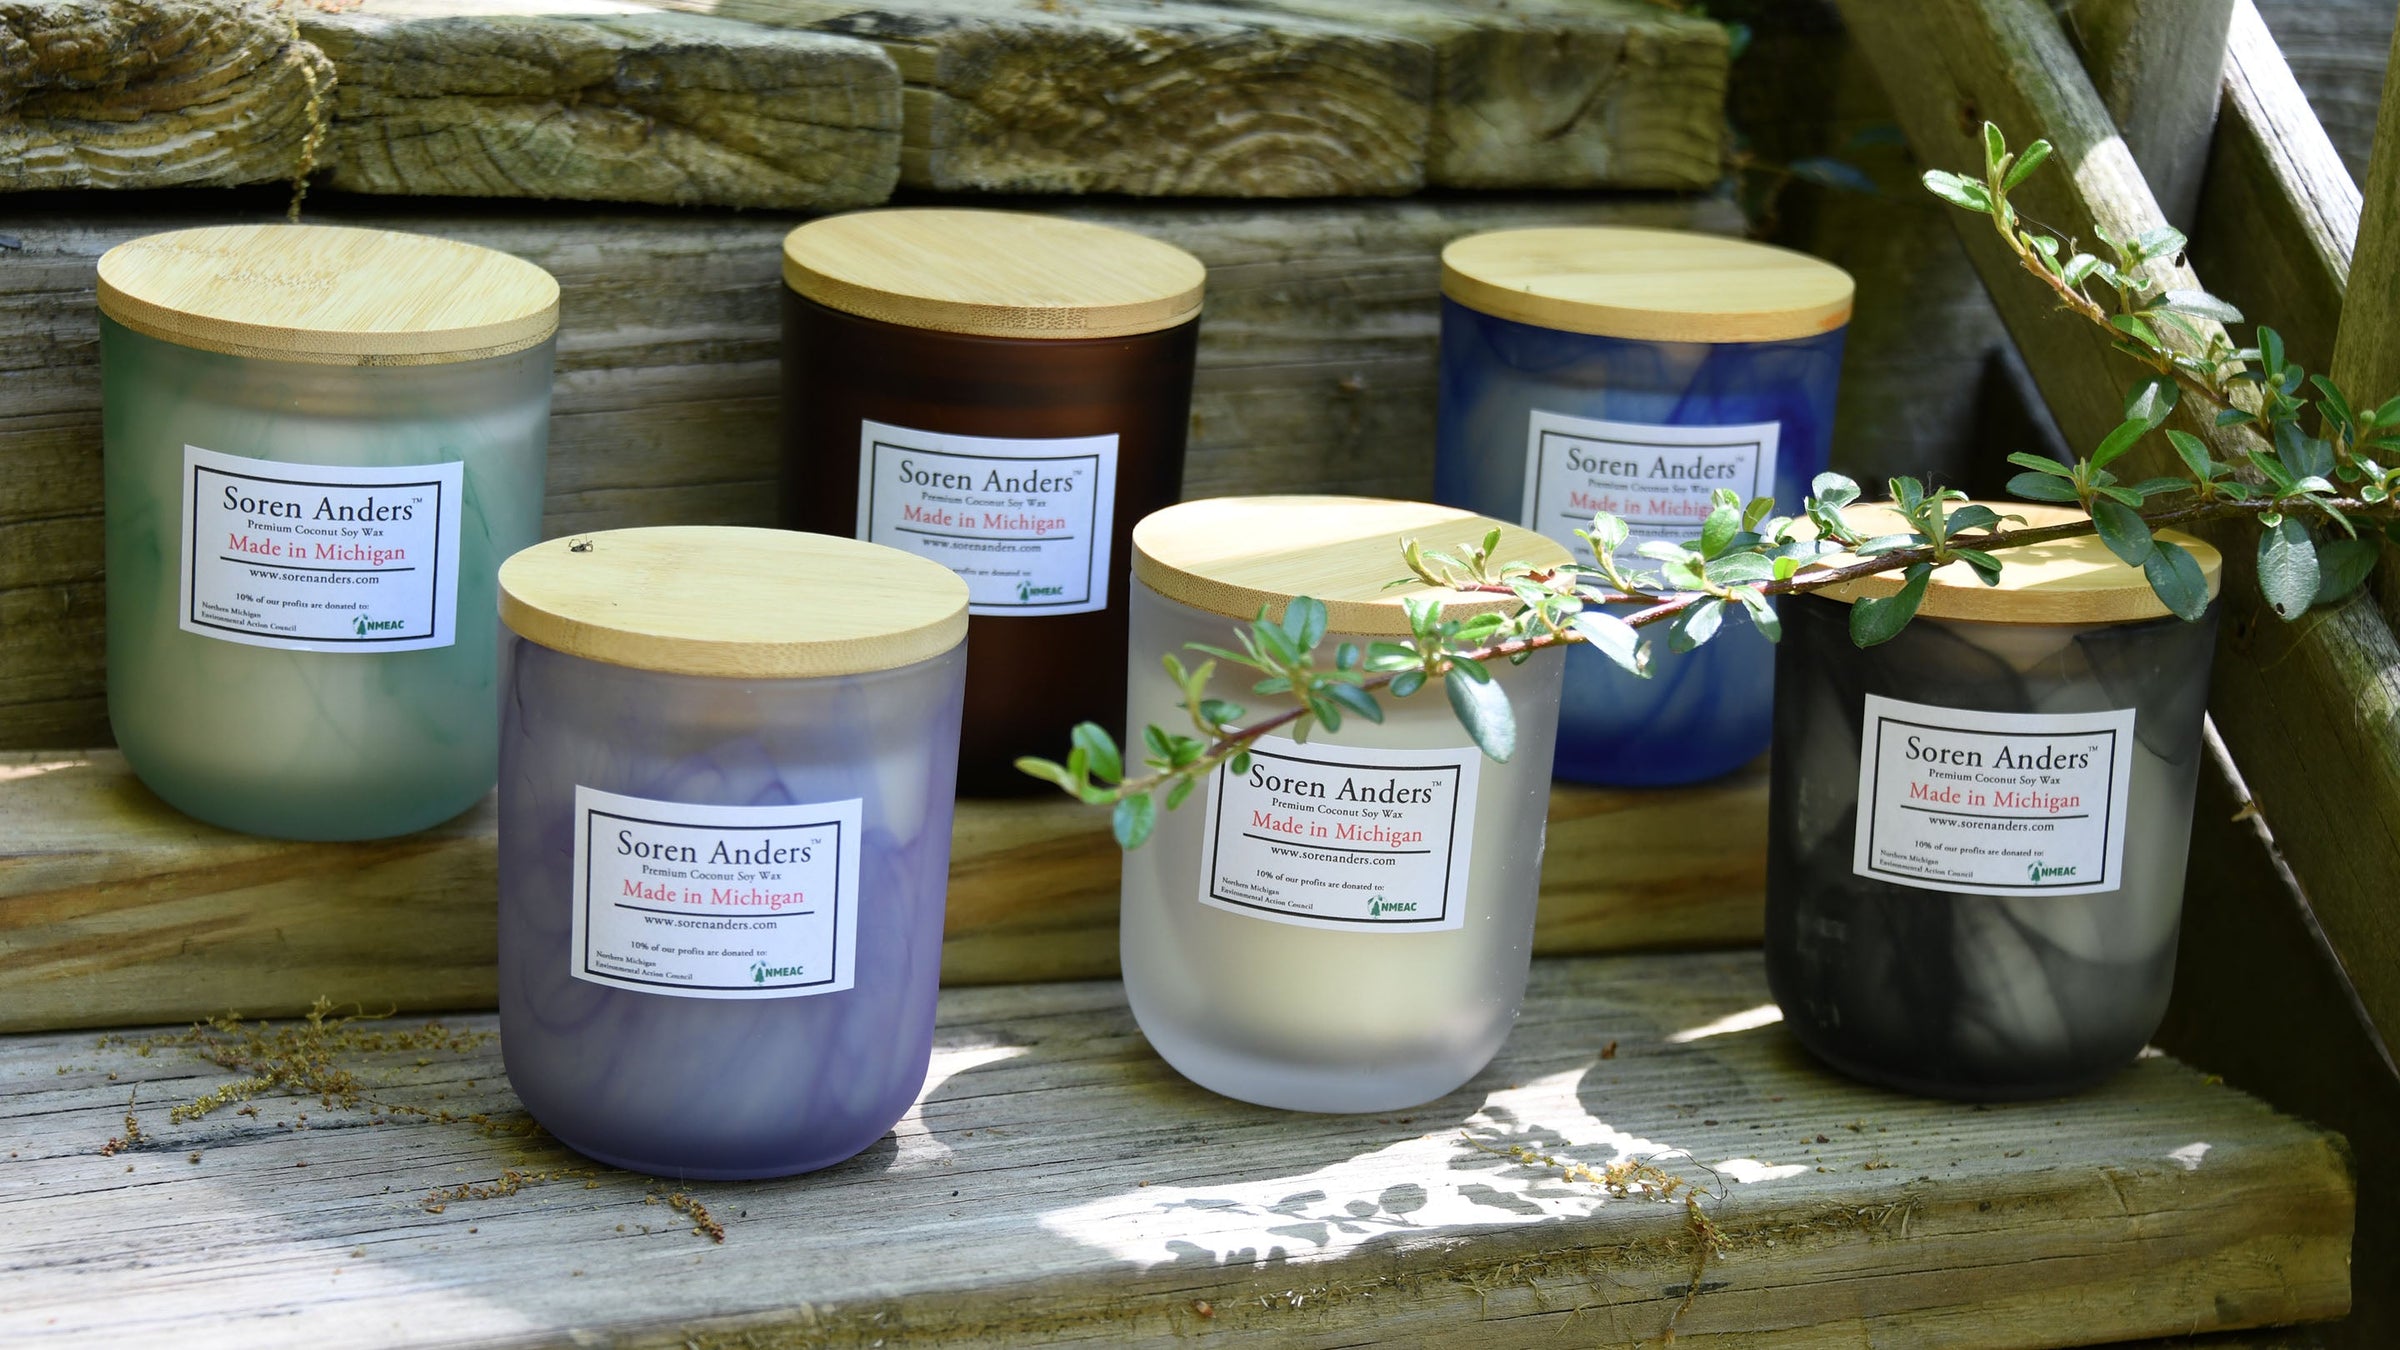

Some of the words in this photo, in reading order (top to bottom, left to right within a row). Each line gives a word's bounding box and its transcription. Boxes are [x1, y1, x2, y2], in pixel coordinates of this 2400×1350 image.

[1566, 448, 1639, 478] Soren
[899, 460, 972, 491] Soren
[223, 486, 302, 519] Soren
[921, 492, 962, 504] Premium
[965, 496, 1004, 507] Coconut
[1007, 499, 1023, 509] Soy
[1027, 499, 1046, 507] Wax
[1569, 491, 1618, 512] Made
[1624, 500, 1640, 515] in
[248, 519, 292, 534] Premium
[295, 524, 338, 537] Coconut
[341, 527, 358, 538] Soy
[361, 528, 384, 537] Wax
[903, 505, 952, 526] Made
[959, 513, 976, 529] in
[983, 513, 1065, 535] Michigan
[228, 533, 281, 556] Made
[288, 543, 307, 559] in
[315, 543, 405, 566] Michigan
[922, 537, 1042, 553] www.sorenanders.com
[249, 569, 379, 585] www.sorenanders.com
[1029, 586, 1063, 596] NMEAC
[236, 593, 254, 602] 10%
[256, 596, 265, 604] of
[282, 600, 308, 610] profits
[324, 601, 356, 610] donated
[230, 608, 261, 619] Michigan
[246, 620, 268, 629] Action
[270, 623, 296, 632] Council
[366, 619, 405, 630] NMEAC
[1905, 735, 1983, 768] Soren
[1249, 764, 1326, 798] Soren
[1929, 768, 1972, 782] Premium
[1975, 774, 2016, 784] Coconut
[2019, 775, 2037, 787] Soy
[2039, 776, 2060, 785] Wax
[1909, 782, 1961, 804] Made
[1967, 790, 1985, 807] in
[1993, 790, 2080, 813] Michigan
[1272, 797, 1315, 812] Premium
[1318, 804, 1359, 817] Coconut
[1362, 808, 1379, 820] Soy
[1382, 809, 1403, 819] Wax
[1252, 810, 1304, 835] Made
[1310, 821, 1327, 838] in
[1335, 823, 1422, 847] Michigan
[1929, 816, 2055, 832] www.sorenanders.com
[617, 830, 698, 864] Soren
[1914, 840, 1932, 850] 10%
[1934, 843, 1943, 851] of
[1960, 846, 1986, 856] profits
[2001, 848, 2031, 857] donated
[1271, 846, 1396, 866] www.sorenanders.com
[1909, 855, 1939, 866] Michigan
[642, 864, 687, 879] Premium
[690, 869, 734, 881] Coconut
[737, 872, 755, 883] Soy
[759, 871, 781, 880] Wax
[1924, 866, 1946, 876] Action
[1948, 869, 1973, 878] Council
[2041, 866, 2076, 876] NMEAC
[1256, 869, 1273, 879] 10%
[1275, 873, 1284, 881] of
[1300, 877, 1326, 888] profits
[1341, 881, 1372, 891] donated
[622, 879, 677, 902] Made
[683, 888, 702, 904] in
[711, 888, 804, 910] Michigan
[1250, 884, 1279, 896] Michigan
[1264, 896, 1286, 906] Action
[1288, 900, 1313, 910] Council
[1380, 902, 1417, 912] NMEAC
[644, 915, 777, 931] www.sorenanders.com
[631, 941, 649, 950] 10%
[651, 943, 660, 951] of
[678, 947, 704, 957] profits
[721, 948, 754, 957] donated
[625, 957, 656, 968] Michigan
[641, 968, 664, 978] Action
[666, 972, 693, 980] Council
[765, 966, 804, 977] NMEAC
